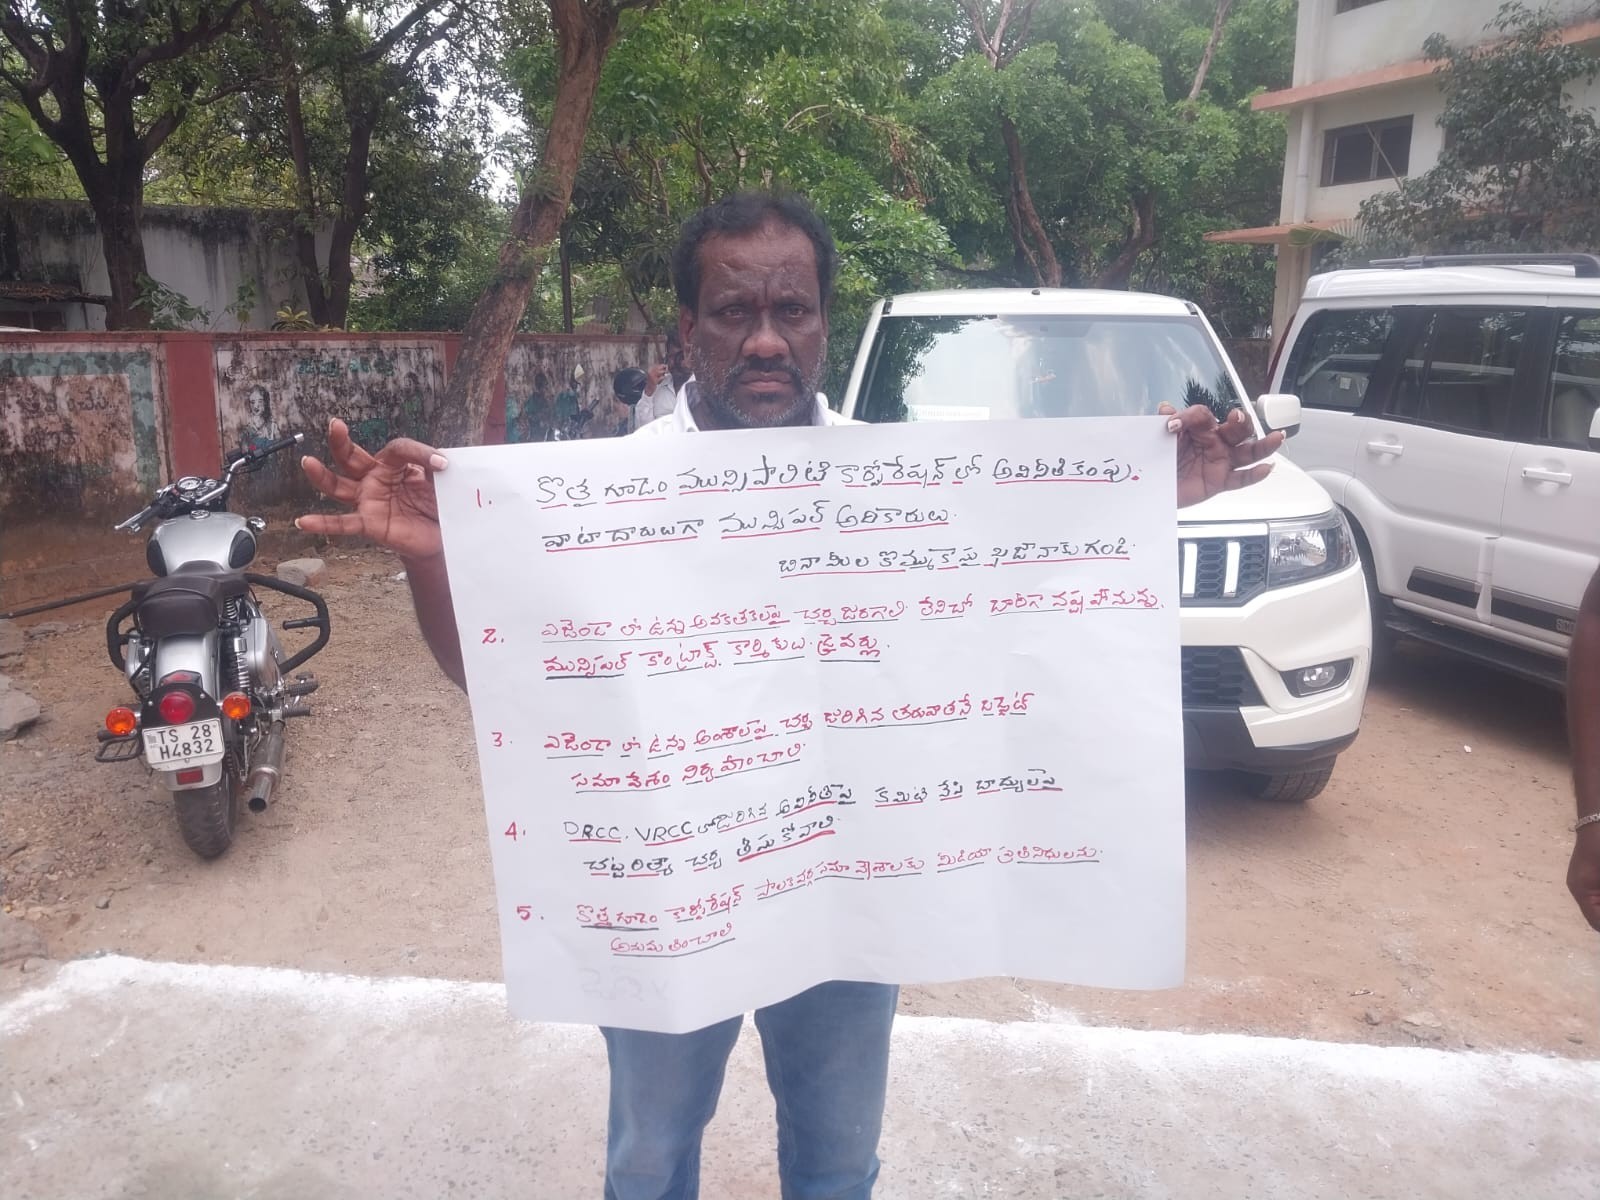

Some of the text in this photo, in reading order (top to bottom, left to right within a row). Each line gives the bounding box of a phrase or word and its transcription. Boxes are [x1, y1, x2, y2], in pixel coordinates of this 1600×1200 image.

[157, 724, 212, 745] TS 28
[160, 739, 214, 761] H4832
[634, 821, 694, 842] VRCC
